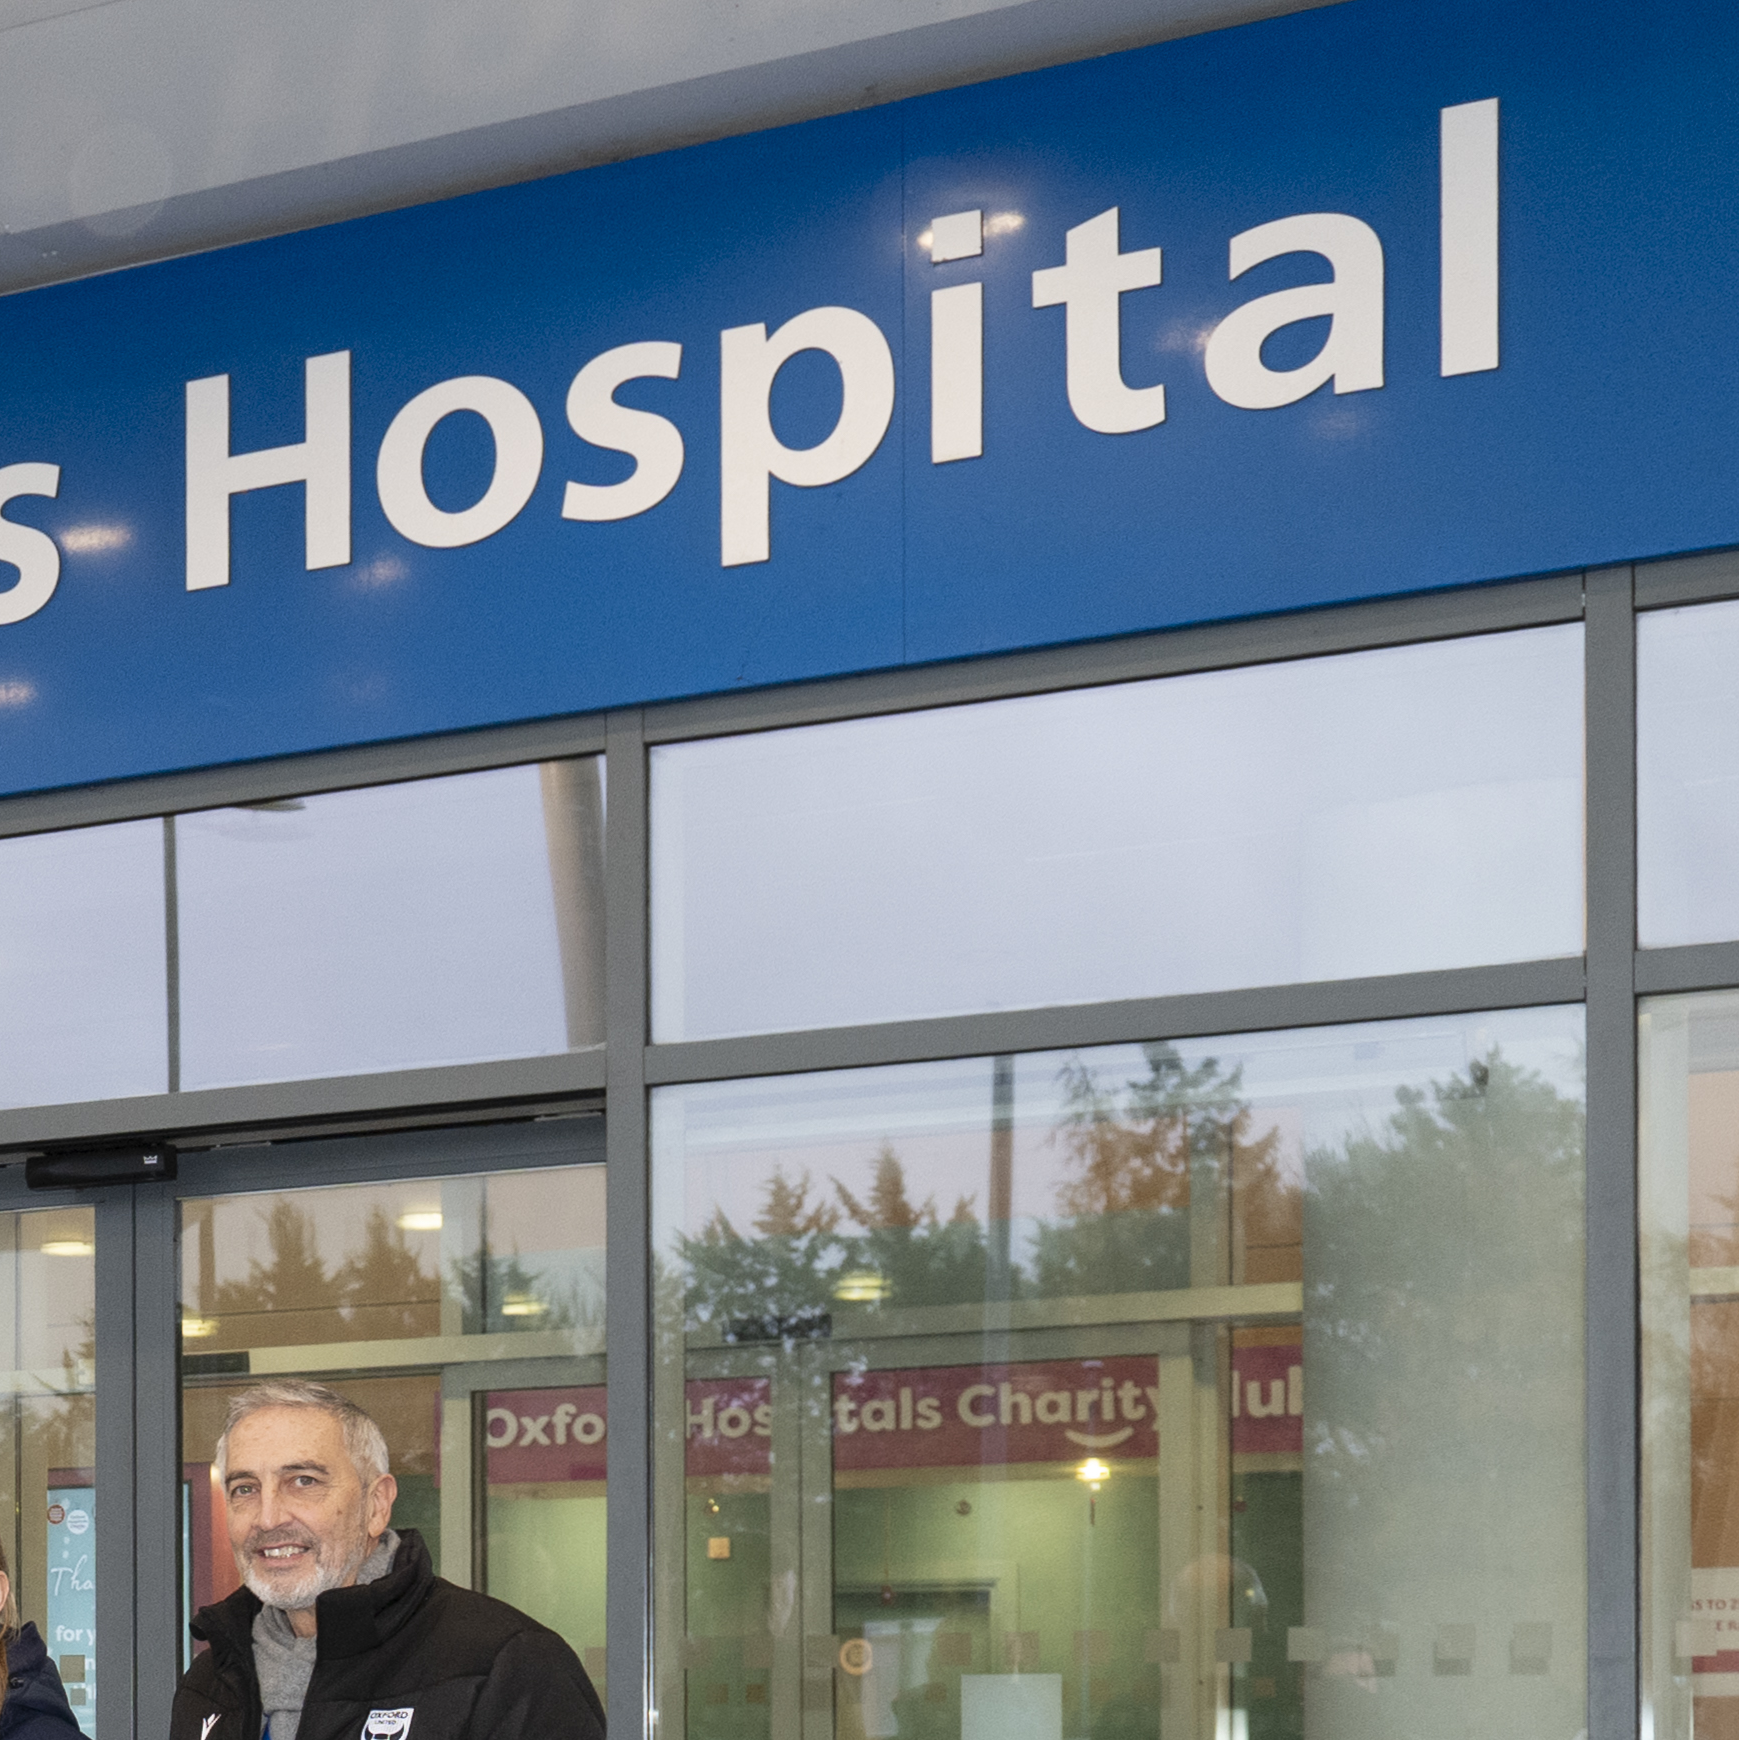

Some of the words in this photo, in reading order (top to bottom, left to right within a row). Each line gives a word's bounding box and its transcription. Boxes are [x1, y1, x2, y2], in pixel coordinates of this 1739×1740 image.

[185, 96, 1500, 592] Hospital
[487, 1403, 607, 1447] Oxfo
[685, 1387, 942, 1440] Hostals
[50, 1554, 94, 1596] Tha
[56, 1624, 83, 1642] for
[370, 1711, 409, 1719] OXFORD
